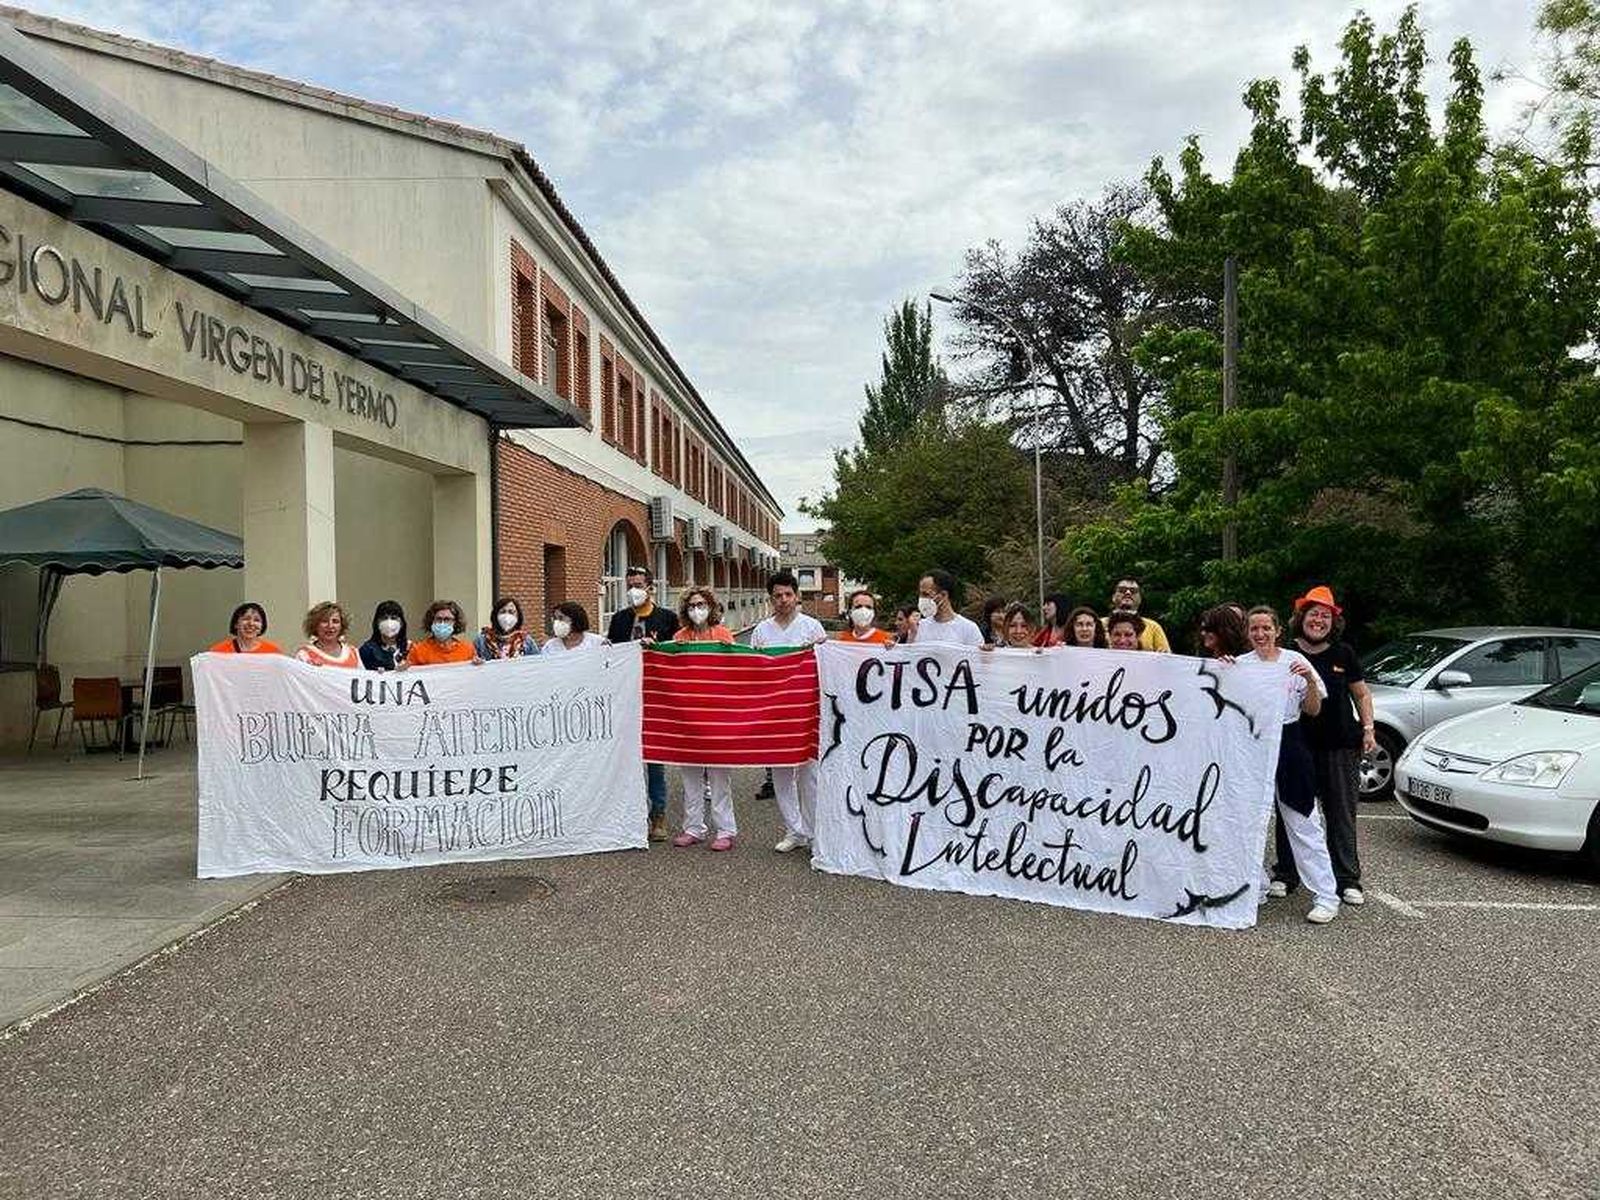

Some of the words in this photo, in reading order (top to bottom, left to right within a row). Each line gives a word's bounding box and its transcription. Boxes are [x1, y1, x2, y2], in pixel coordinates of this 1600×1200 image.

[175, 301, 285, 388] VIRGEN
[291, 353, 330, 404] DEL
[333, 370, 398, 429] YERMO
[350, 678, 431, 706] UNA
[855, 657, 980, 714] CTSA
[1010, 667, 1178, 744] unidos
[237, 712, 378, 764] BUENA
[966, 722, 1029, 761] POR
[1044, 727, 1084, 772] la
[861, 732, 1221, 852] Discapacidad
[900, 811, 1138, 900] Intelectual
